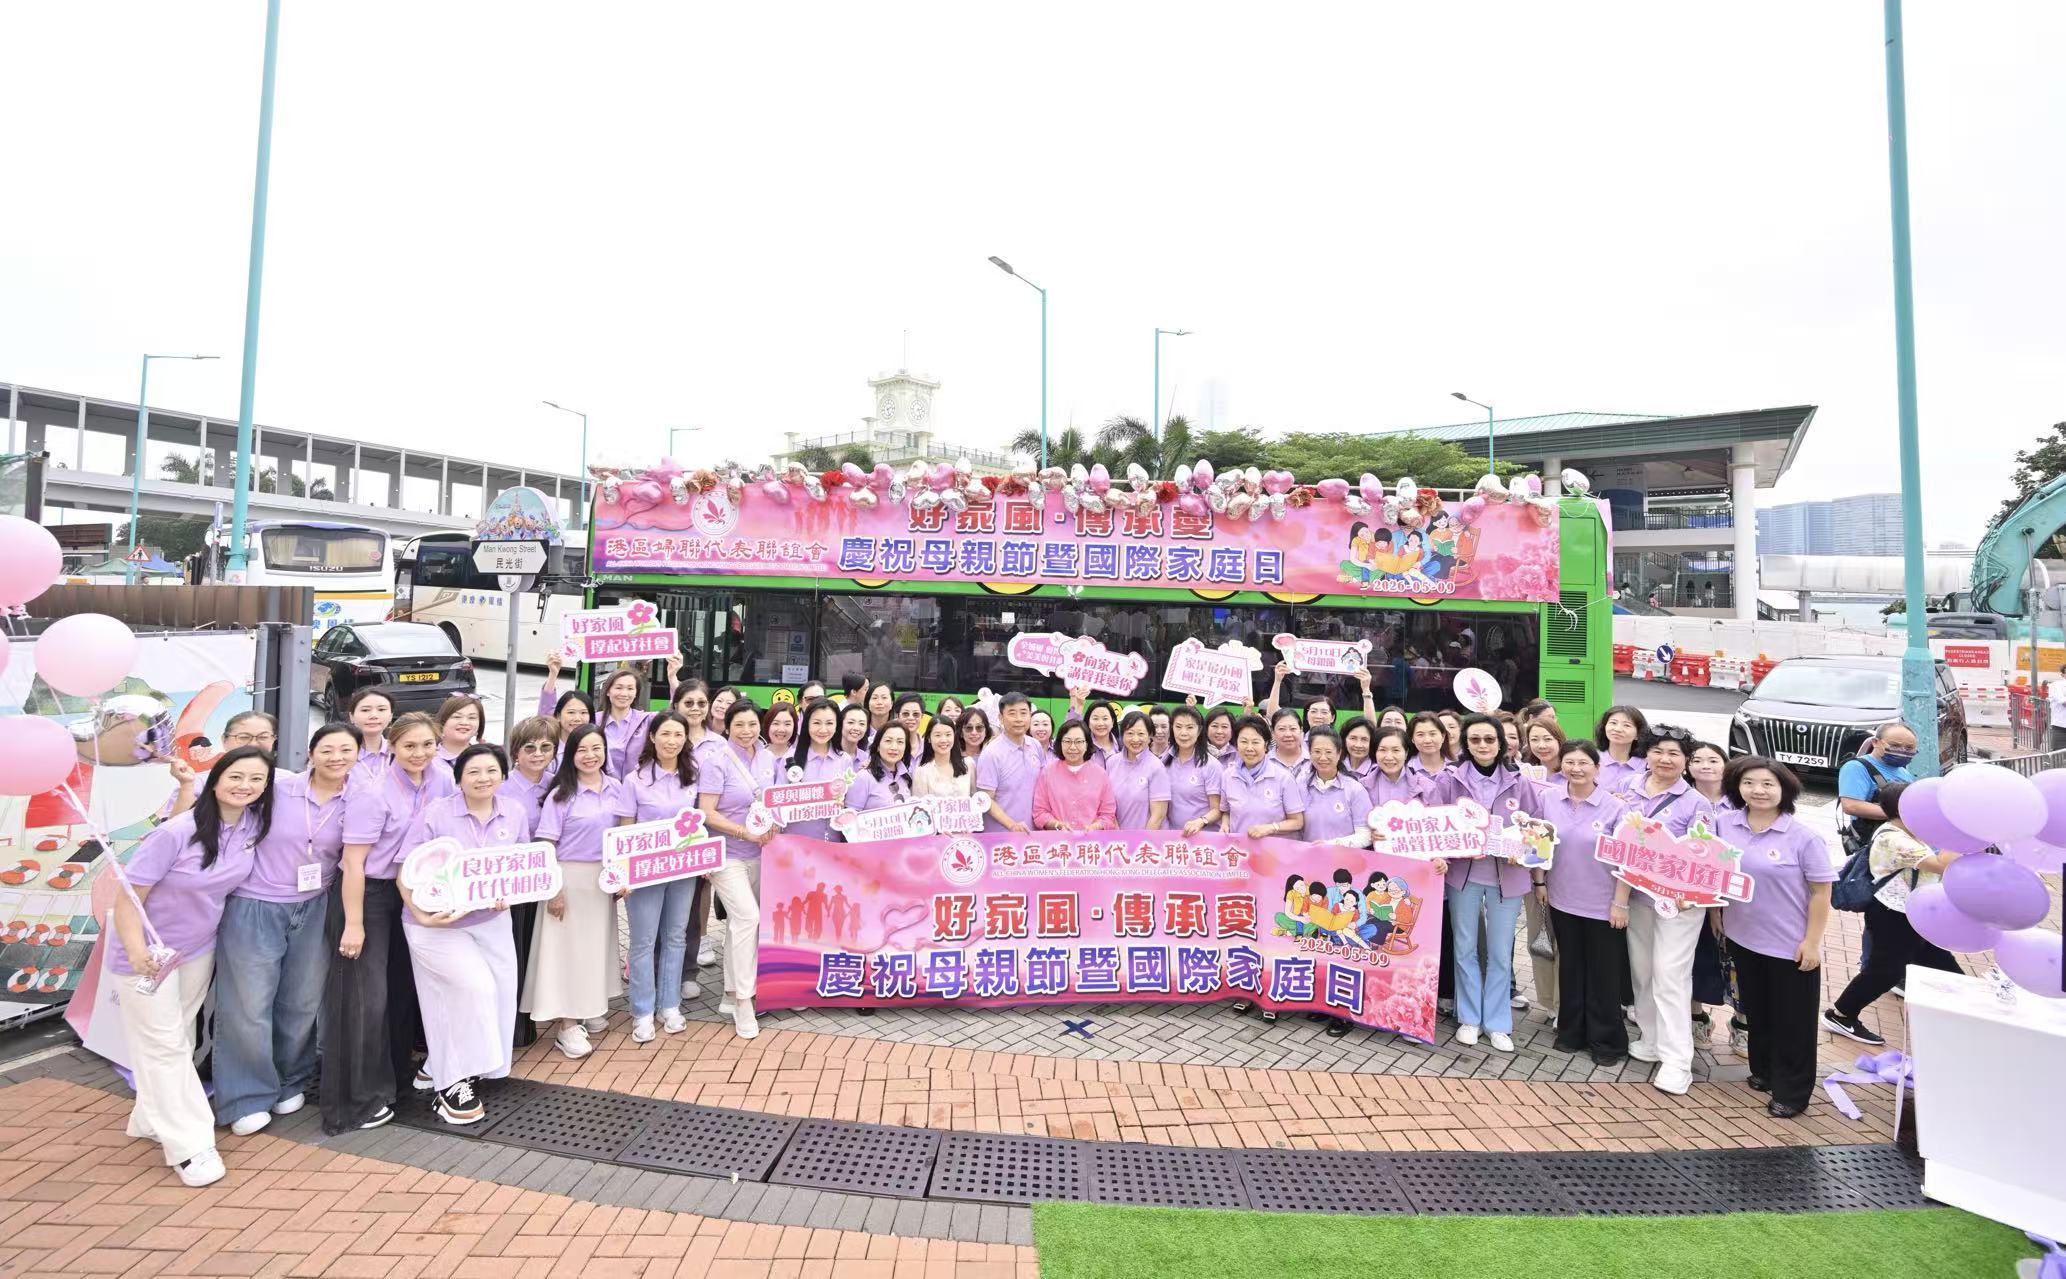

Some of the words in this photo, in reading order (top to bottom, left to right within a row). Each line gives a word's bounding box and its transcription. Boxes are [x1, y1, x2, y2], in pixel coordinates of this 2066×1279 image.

[497, 545, 517, 553] Kwong
[606, 537, 828, 561] 港區婦聯代表聯誼會
[839, 537, 1283, 583] 慶祝母親節暨國際家庭日
[495, 557, 523, 569] 民光街
[602, 574, 633, 582] MAN
[1373, 579, 1456, 594] 2026-05-09
[572, 616, 625, 634] 好家風
[418, 673, 434, 681] 1212
[1084, 655, 1121, 676] 向家人
[1067, 665, 1133, 691] 講聲我愛你
[1797, 756, 1824, 766] 7259
[1405, 815, 1458, 834] 向家人
[616, 829, 671, 855] 好家風
[1392, 832, 1480, 854] 講聲我愛你
[462, 850, 547, 878] 良好家風
[993, 843, 1248, 867] 港區婦聯代表聯誼會
[1597, 835, 1753, 900] 國際家庭日
[468, 872, 552, 901] 代代相傳
[933, 892, 1257, 939] 好家風·傳承愛
[1300, 937, 1390, 967] 2026-05-09
[817, 946, 1365, 1014] 慶祝母親節暨國際家庭日
